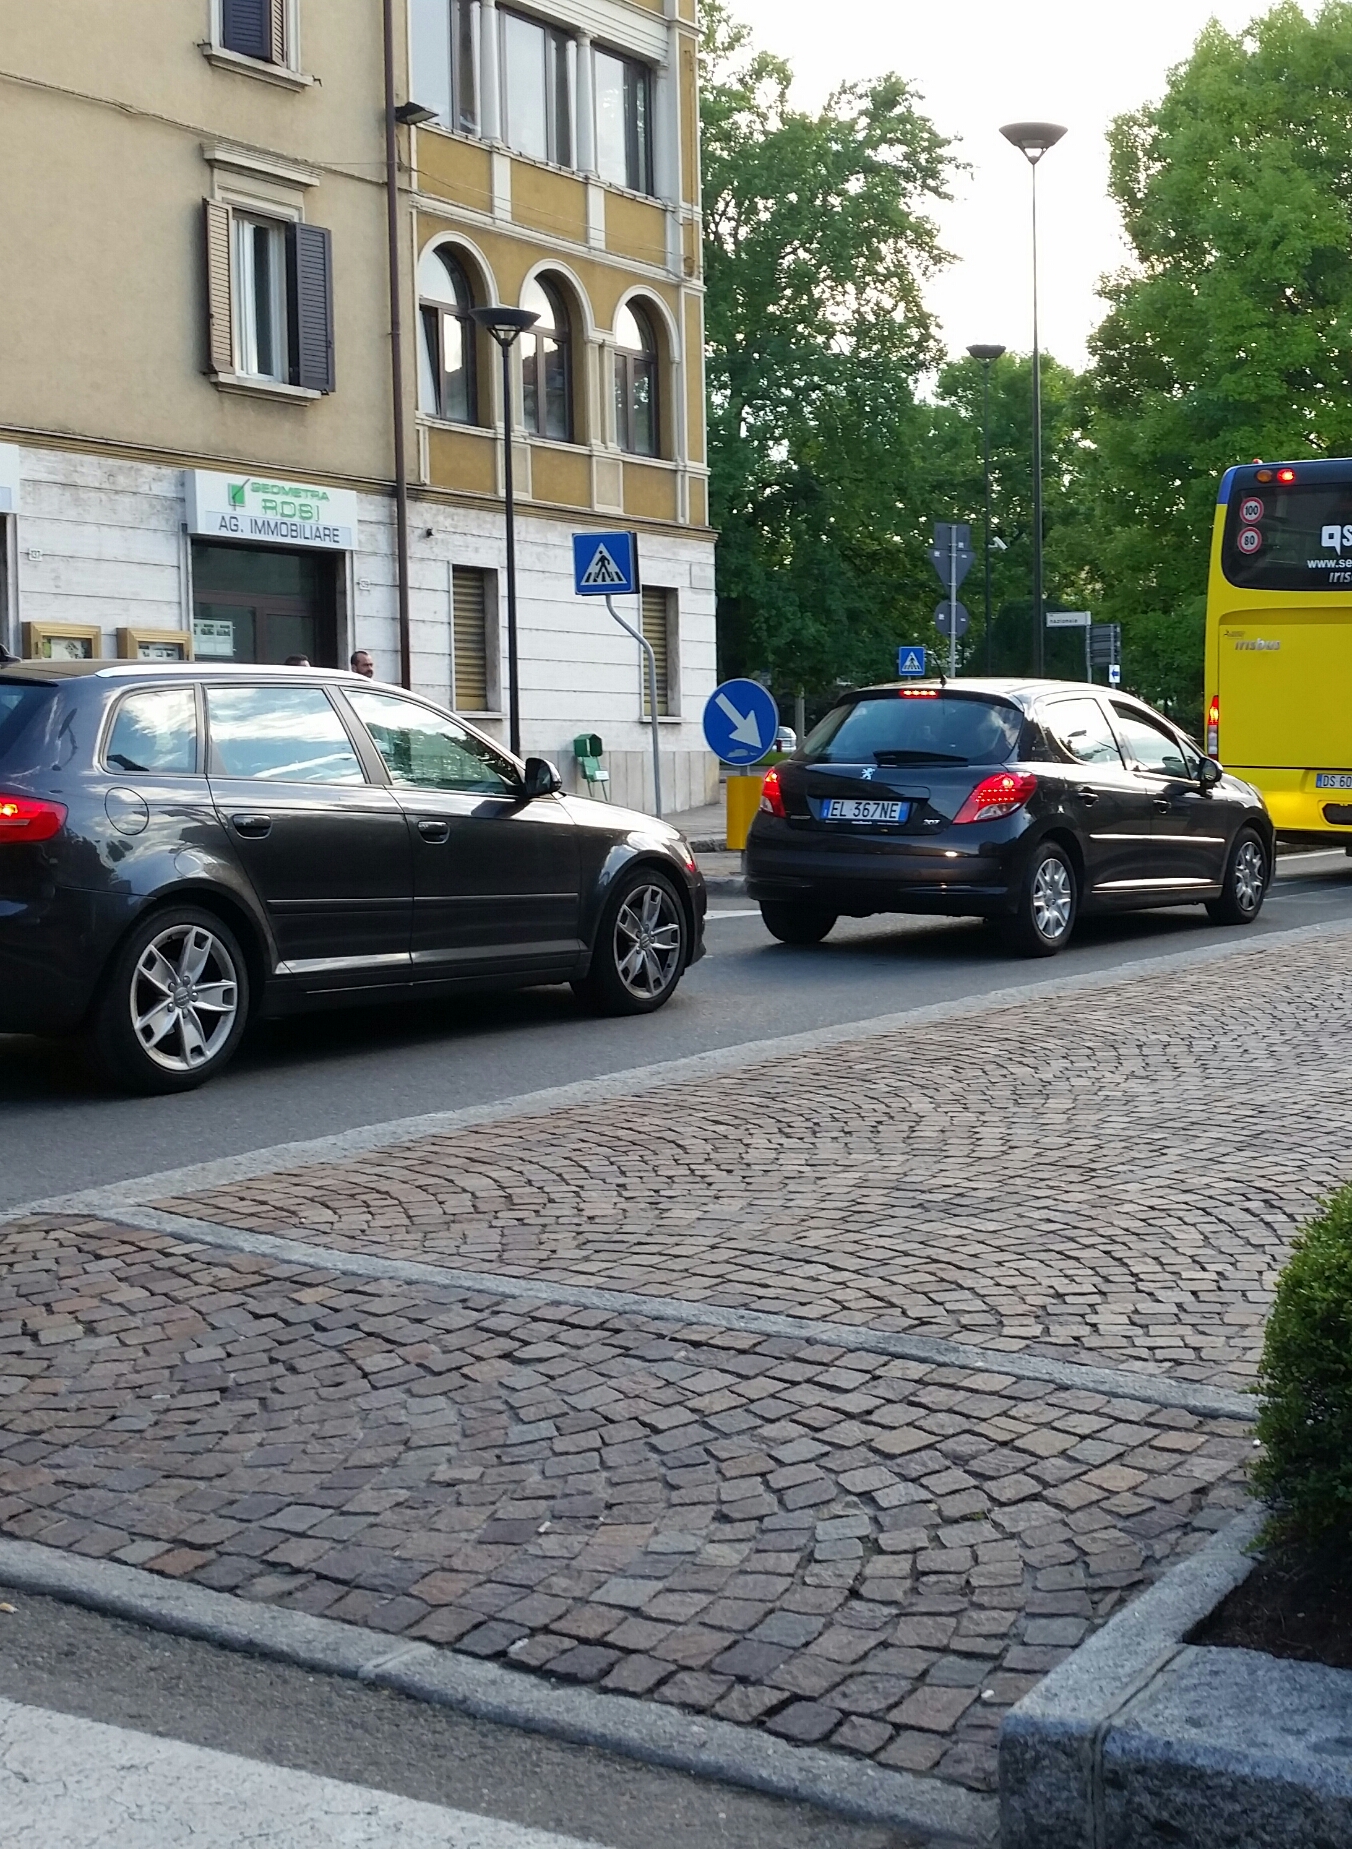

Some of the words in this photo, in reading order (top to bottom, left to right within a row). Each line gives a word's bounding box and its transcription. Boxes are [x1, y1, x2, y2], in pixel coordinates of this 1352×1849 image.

[250, 482, 330, 501] GEOMETRA
[262, 498, 320, 522] ROSI
[1244, 504, 1259, 516] 100
[218, 515, 244, 533] AG.
[250, 518, 340, 543] IMMOBILIARE
[1244, 534, 1256, 546] 80
[1322, 775, 1336, 787] DS
[830, 801, 847, 817] EL
[852, 802, 899, 819] 367NE
